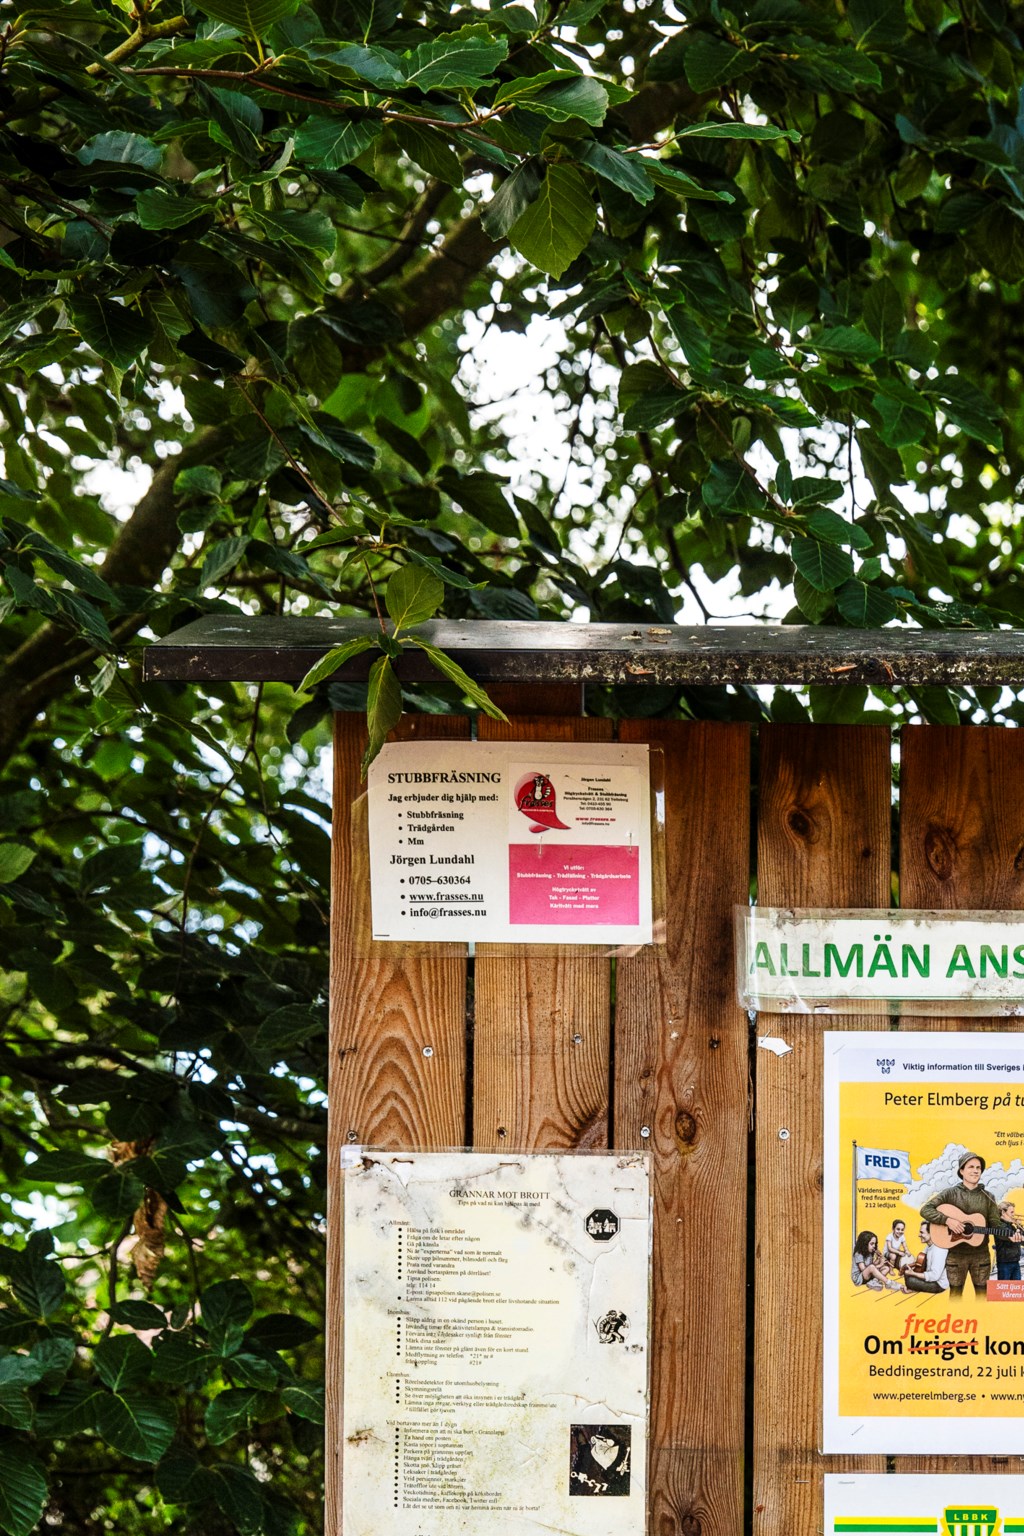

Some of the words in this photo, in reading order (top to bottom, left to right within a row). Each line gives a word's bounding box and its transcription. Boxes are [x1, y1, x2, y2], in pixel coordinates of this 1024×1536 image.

[388, 770, 500, 783] STUBBFRÄSNING
[388, 794, 402, 803] Jag
[404, 794, 439, 803] erbjuder
[441, 794, 454, 803] dig
[456, 794, 476, 803] hjälp
[407, 811, 464, 820] Stubbfräsning
[407, 824, 454, 833] Trädgården
[390, 855, 426, 866] Jörgen
[430, 855, 474, 864] Lundahl
[410, 892, 484, 903] www.frasses.nu
[410, 908, 486, 918] info@frasses.nu
[750, 935, 930, 978] ALLMÄN
[903, 1063, 925, 1072] Viktig
[987, 1064, 1020, 1072] Sveriges
[885, 1092, 923, 1105] Peter
[928, 1093, 988, 1110] Elmberg
[993, 1092, 1011, 1110] på
[864, 1154, 901, 1168] FRED
[449, 1190, 494, 1198] GRANNAR
[498, 1191, 518, 1199] MOT
[520, 1191, 550, 1199] BROTT
[1010, 1283, 1020, 1291] ljus
[902, 1314, 977, 1338] freden
[864, 1335, 902, 1354] Om
[911, 1335, 978, 1361] kriget
[870, 1365, 972, 1380] Beddingestrand,
[977, 1367, 992, 1377] 22
[996, 1366, 1016, 1379] juli
[873, 1391, 976, 1402] www.peterelmberg.se
